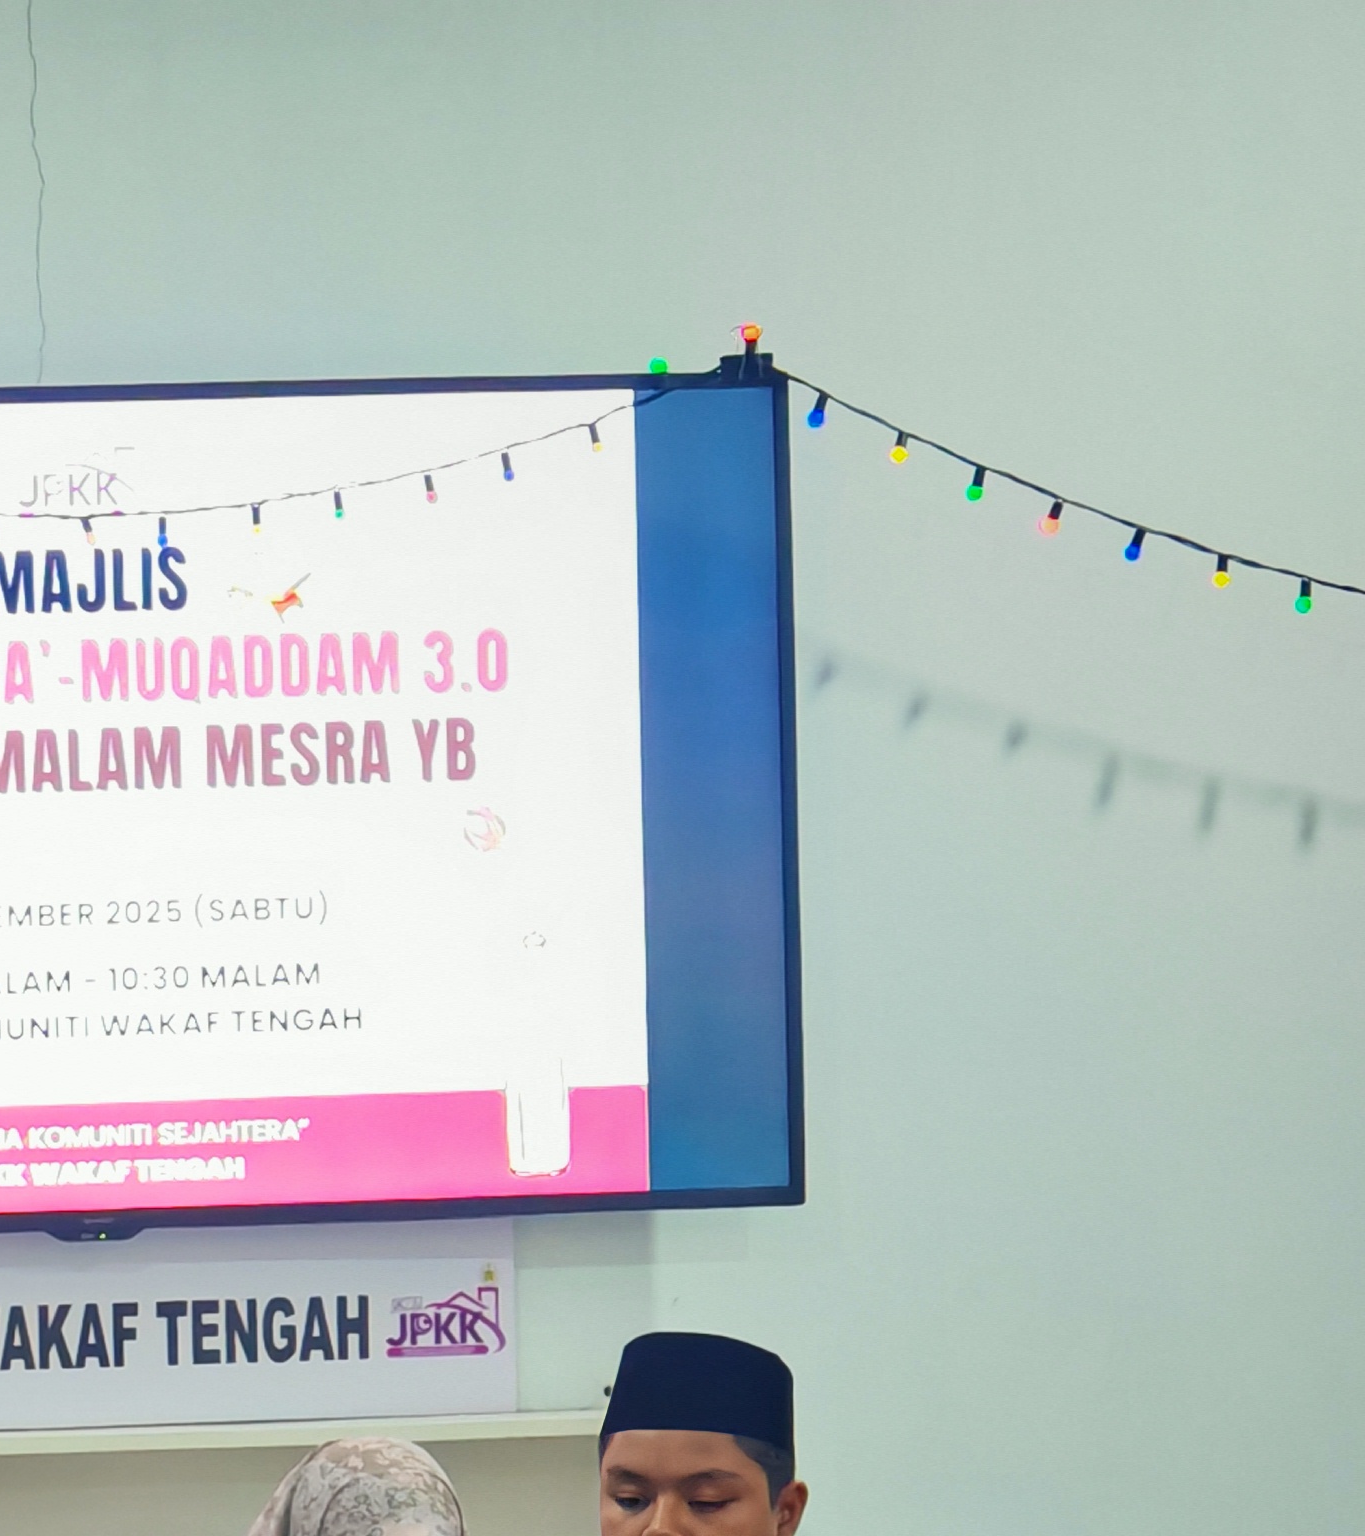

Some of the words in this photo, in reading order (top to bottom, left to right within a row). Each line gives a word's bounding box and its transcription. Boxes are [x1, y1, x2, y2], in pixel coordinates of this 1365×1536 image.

[19, 470, 118, 507] JPKK
[422, 627, 509, 694] 3.0
[205, 720, 392, 789] MESRA
[410, 717, 477, 784] YB
[106, 899, 182, 925] 2025
[194, 889, 328, 929] (SABTU)
[108, 965, 189, 992] 10:30
[200, 962, 320, 990] MALAM
[100, 1012, 220, 1037] WAKAF
[230, 1007, 363, 1033] TENGAH
[27, 1122, 153, 1151] KOMUNITI
[28, 1159, 133, 1188] WAKAF
[132, 1155, 246, 1184] TENGAH
[155, 1294, 370, 1366] TENGAH
[385, 1310, 485, 1347] JPKK
